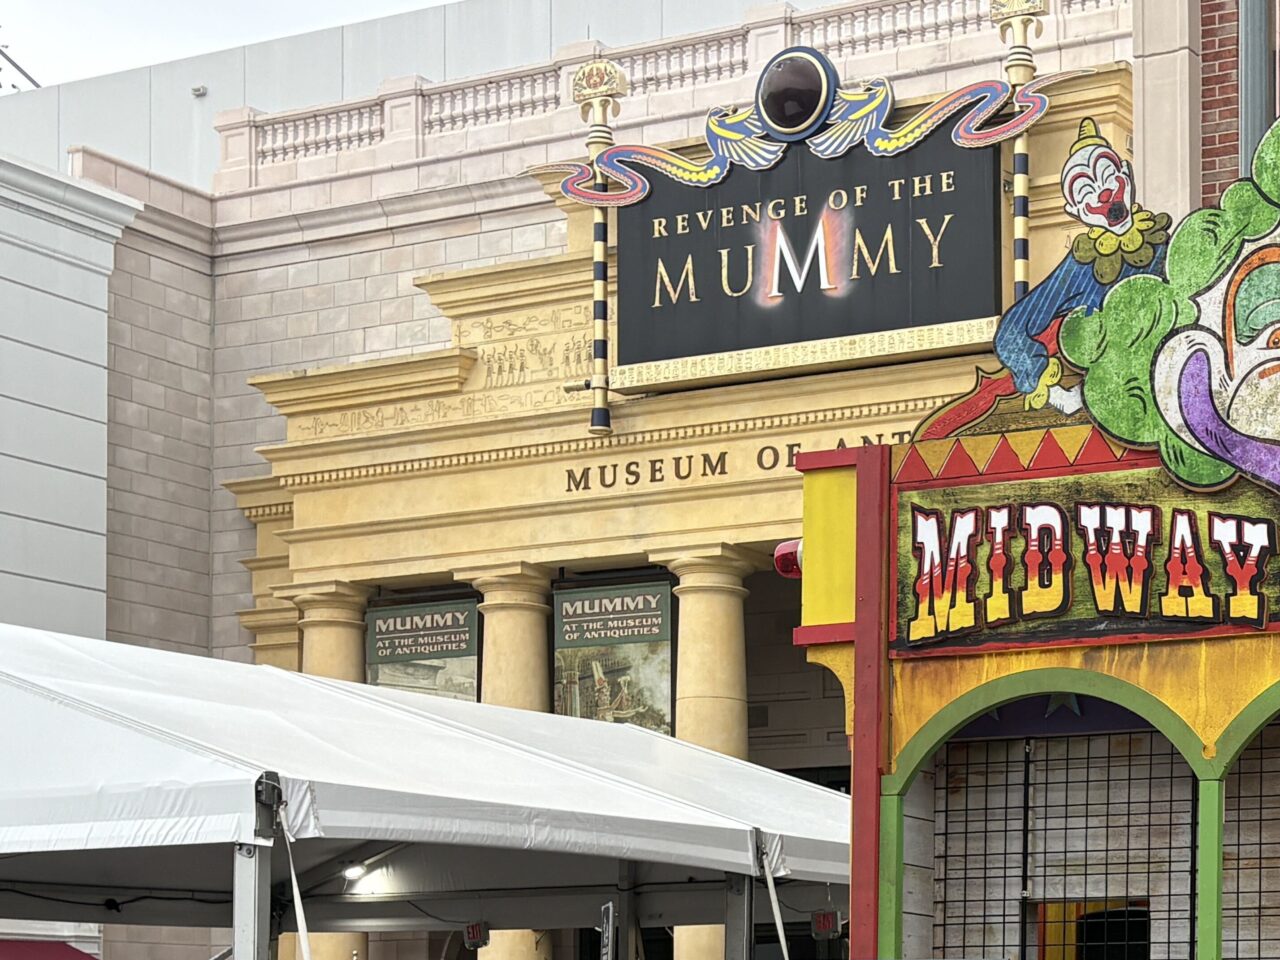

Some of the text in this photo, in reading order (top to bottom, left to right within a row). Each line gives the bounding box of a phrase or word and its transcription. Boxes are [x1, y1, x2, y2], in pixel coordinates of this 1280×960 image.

[652, 171, 955, 238] REVENGE OF THE
[651, 213, 955, 308] MUMMY
[565, 442, 801, 492] MUSEUM OF
[906, 502, 1277, 646] MIDWAY
[562, 594, 661, 616] MUMMY
[375, 611, 468, 633] MUMMY
[563, 617, 662, 632] AT THE MUSEUM
[376, 633, 470, 648] AT THE MUSEUM
[564, 626, 660, 641] OF ANTIQUITIES
[378, 641, 468, 657] OF ANTIQUITIES
